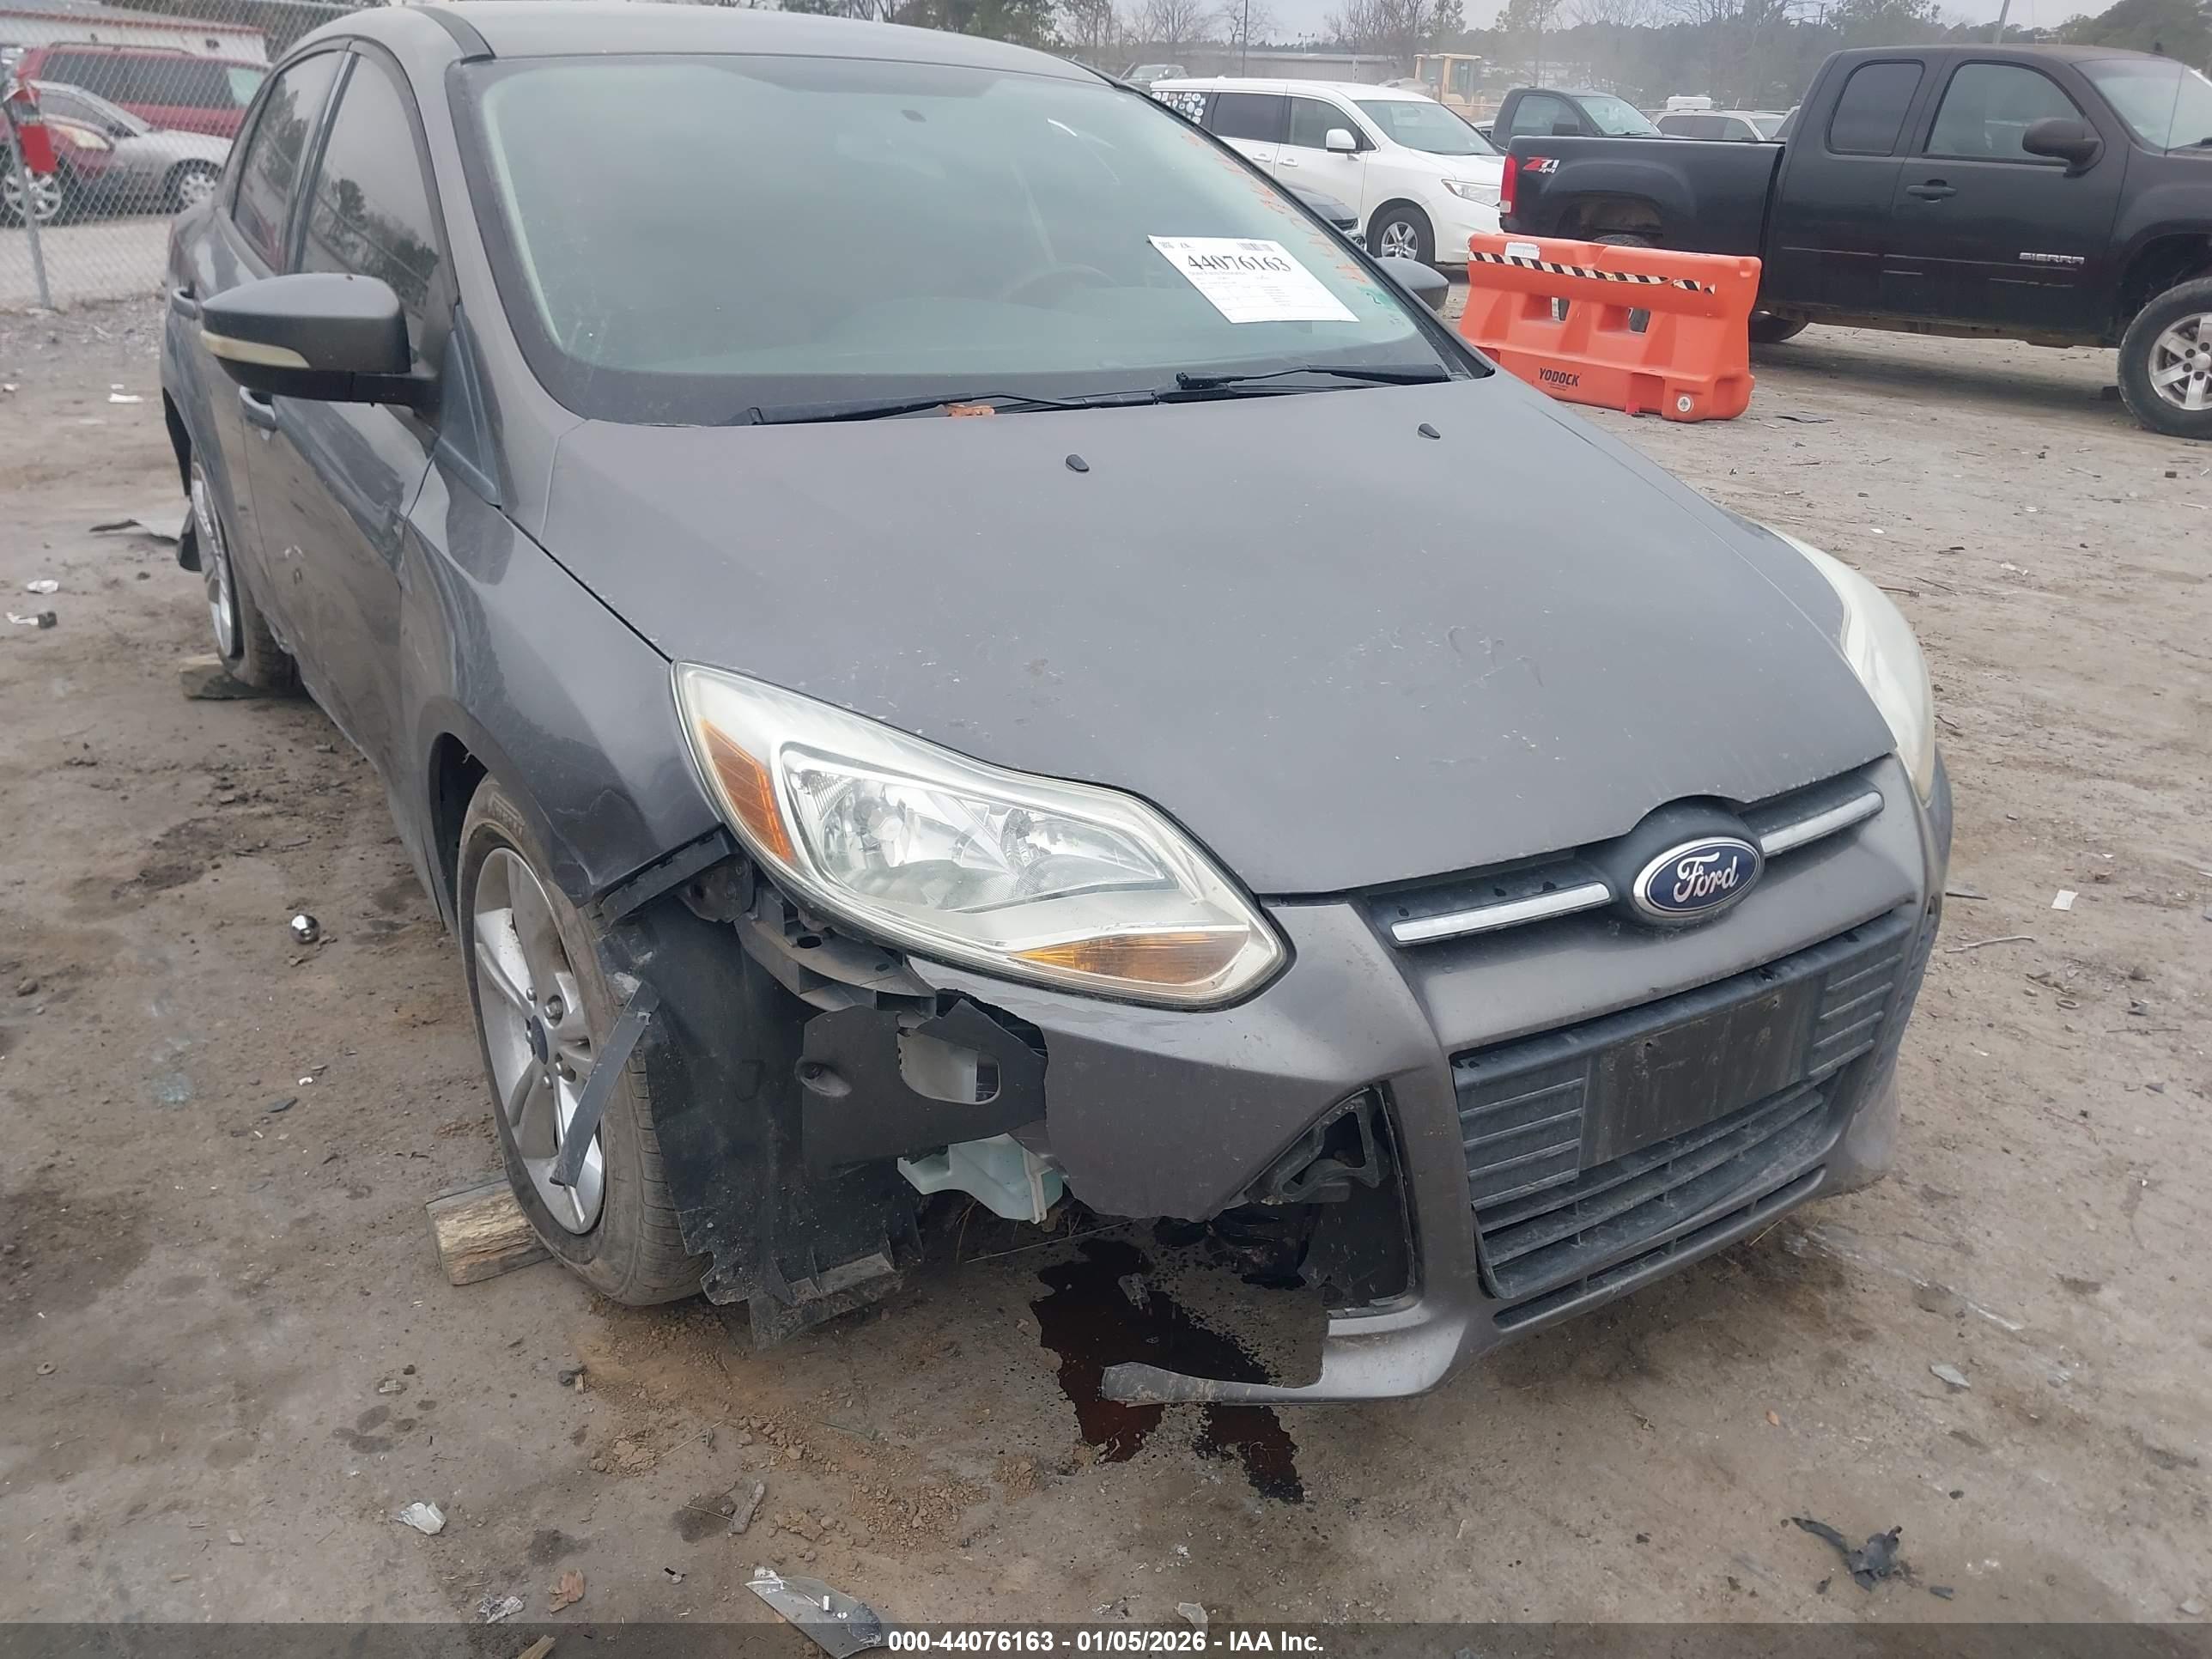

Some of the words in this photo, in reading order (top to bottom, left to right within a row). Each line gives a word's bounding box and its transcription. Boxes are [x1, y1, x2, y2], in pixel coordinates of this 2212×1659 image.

[1523, 157, 1559, 170] Z71
[1188, 255, 1291, 271] 44076163
[2019, 252, 2085, 264] SIERRA
[1540, 368, 1580, 387] YODOCK
[1673, 851, 1739, 902] Ford
